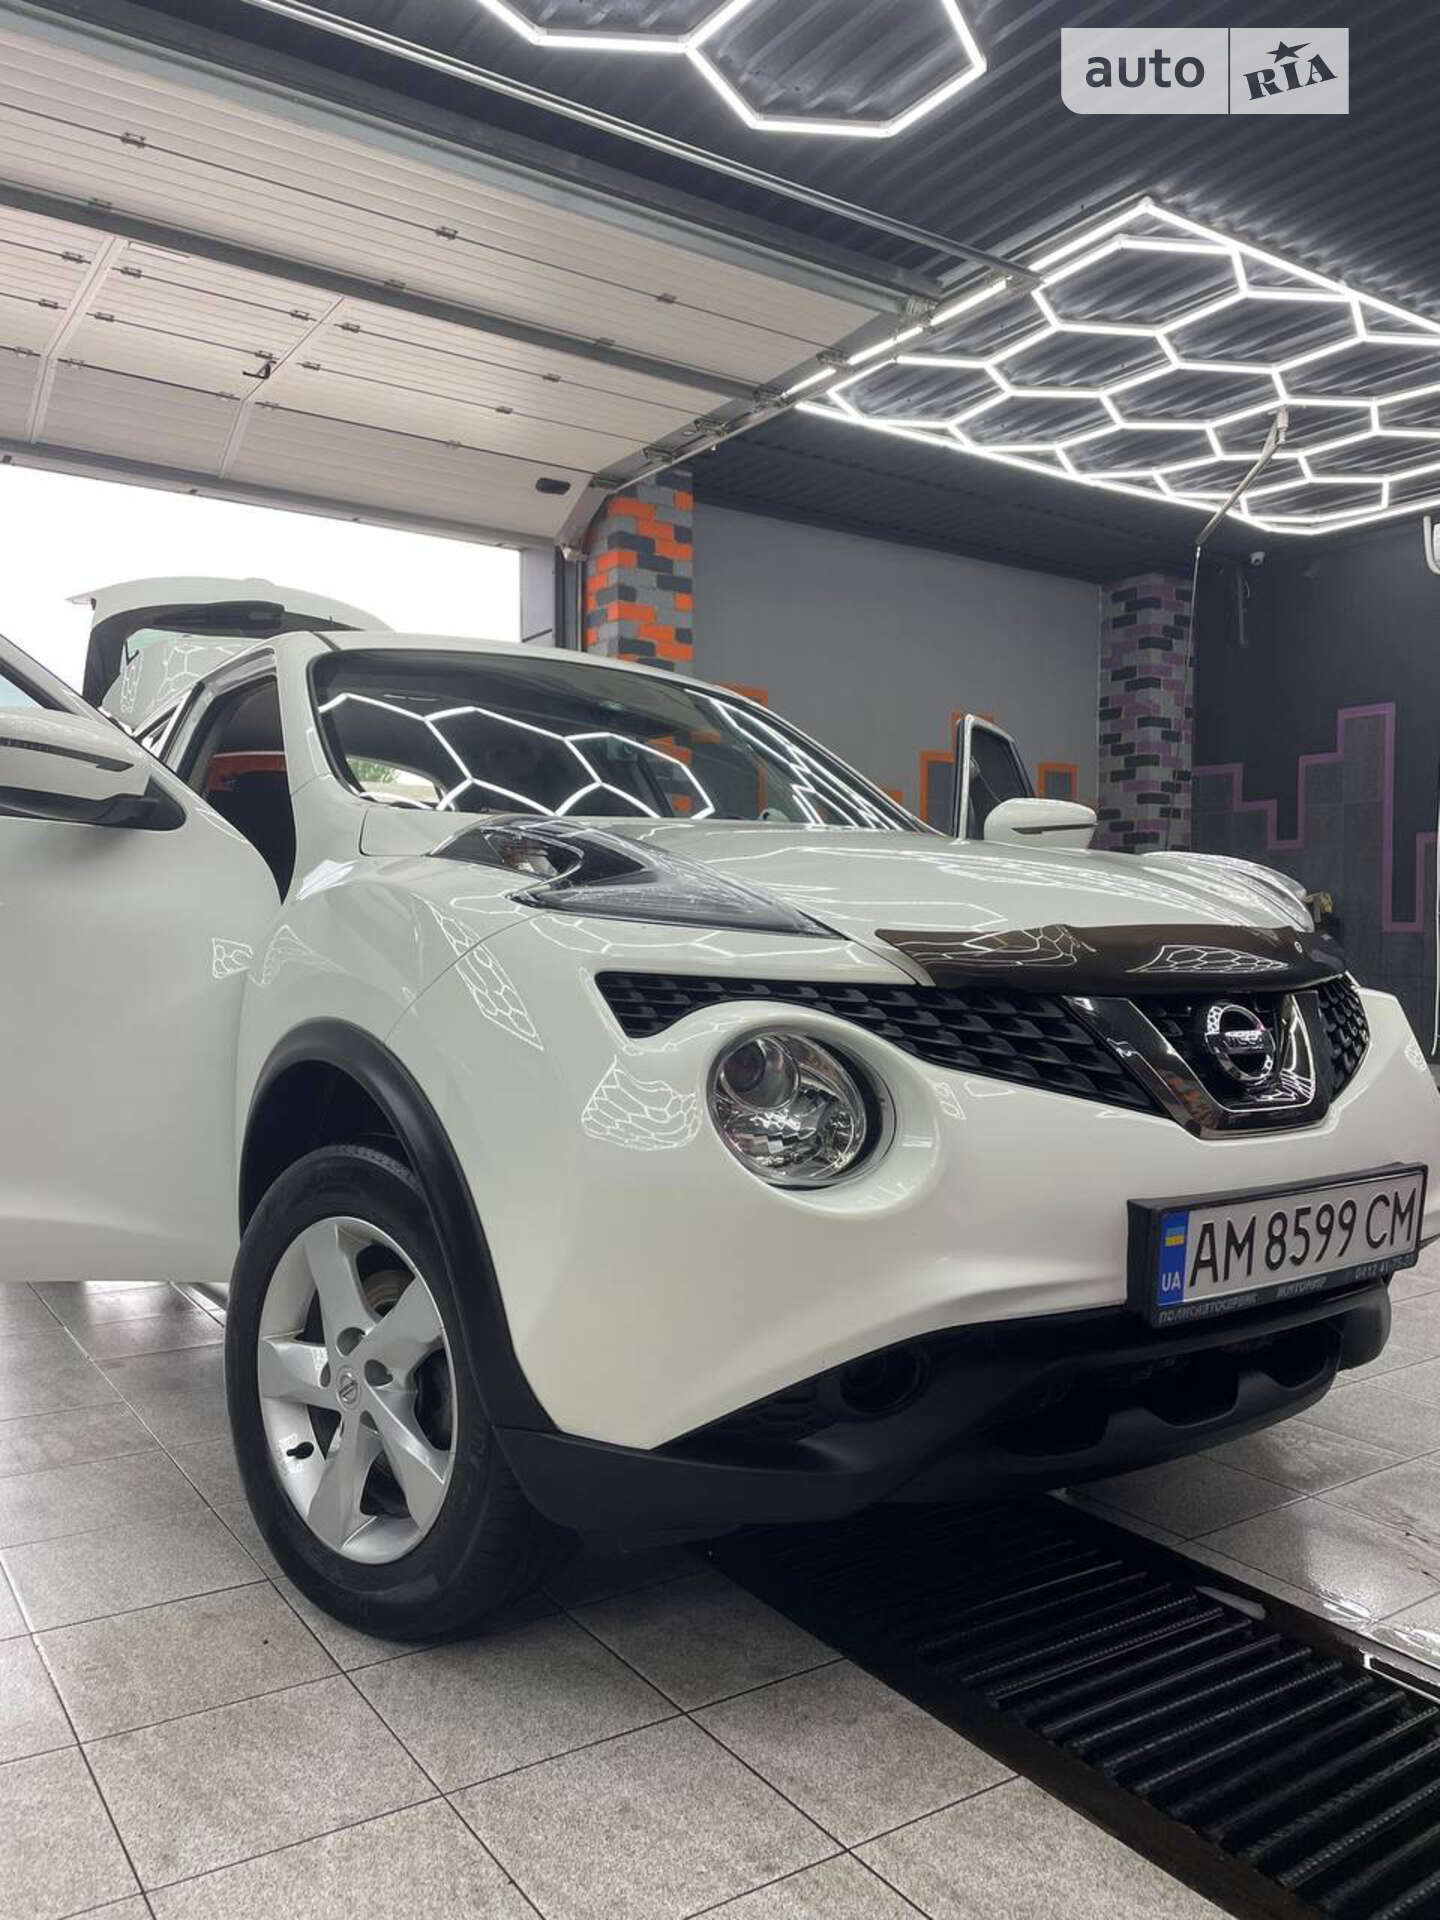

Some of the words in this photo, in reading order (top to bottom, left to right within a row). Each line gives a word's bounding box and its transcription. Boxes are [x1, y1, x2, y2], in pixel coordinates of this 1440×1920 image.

[1189, 1216, 1256, 1287] AM
[1265, 1199, 1357, 1271] 8599
[1366, 1187, 1416, 1249] CM
[1161, 1271, 1181, 1292] UA
